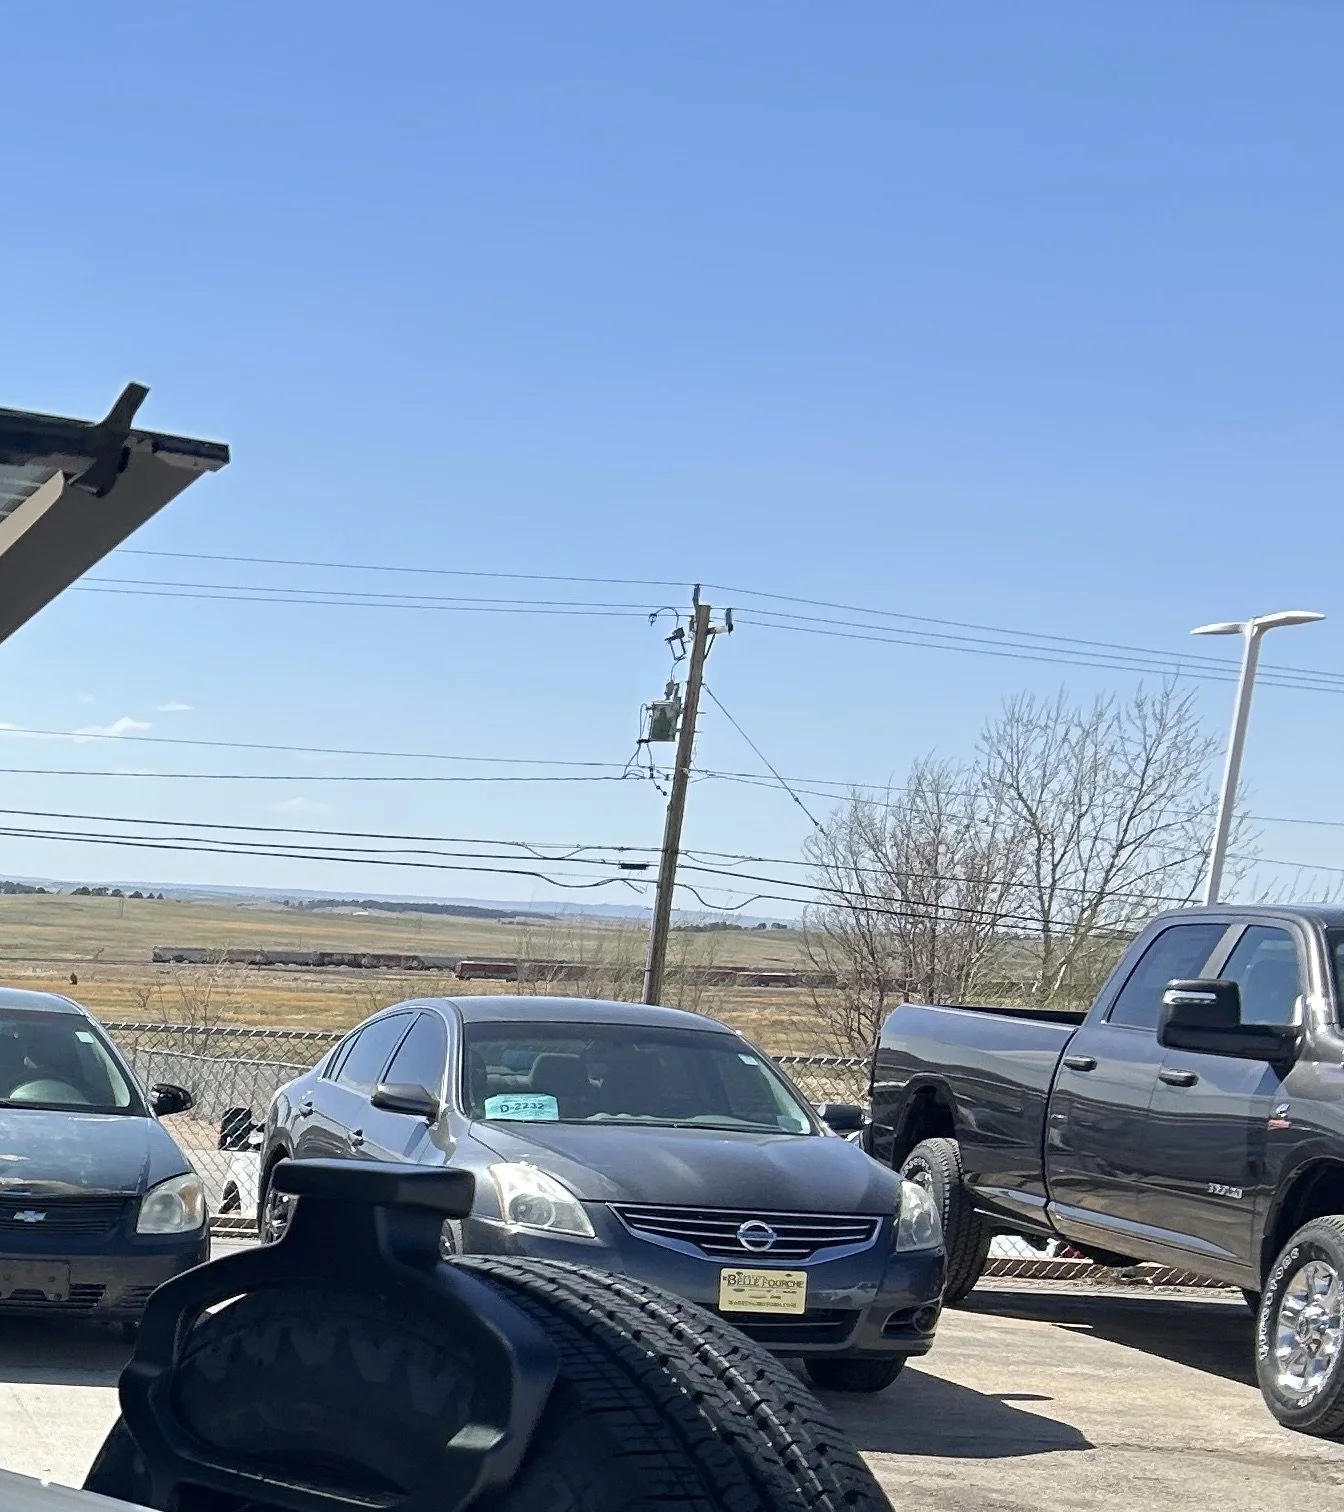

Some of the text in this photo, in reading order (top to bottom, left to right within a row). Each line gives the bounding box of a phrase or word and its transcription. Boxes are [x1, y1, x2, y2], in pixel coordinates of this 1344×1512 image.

[500, 1102, 545, 1113] D-2232
[727, 1274, 760, 1287] BELLE
[762, 1279, 805, 1289] FOURCHE
